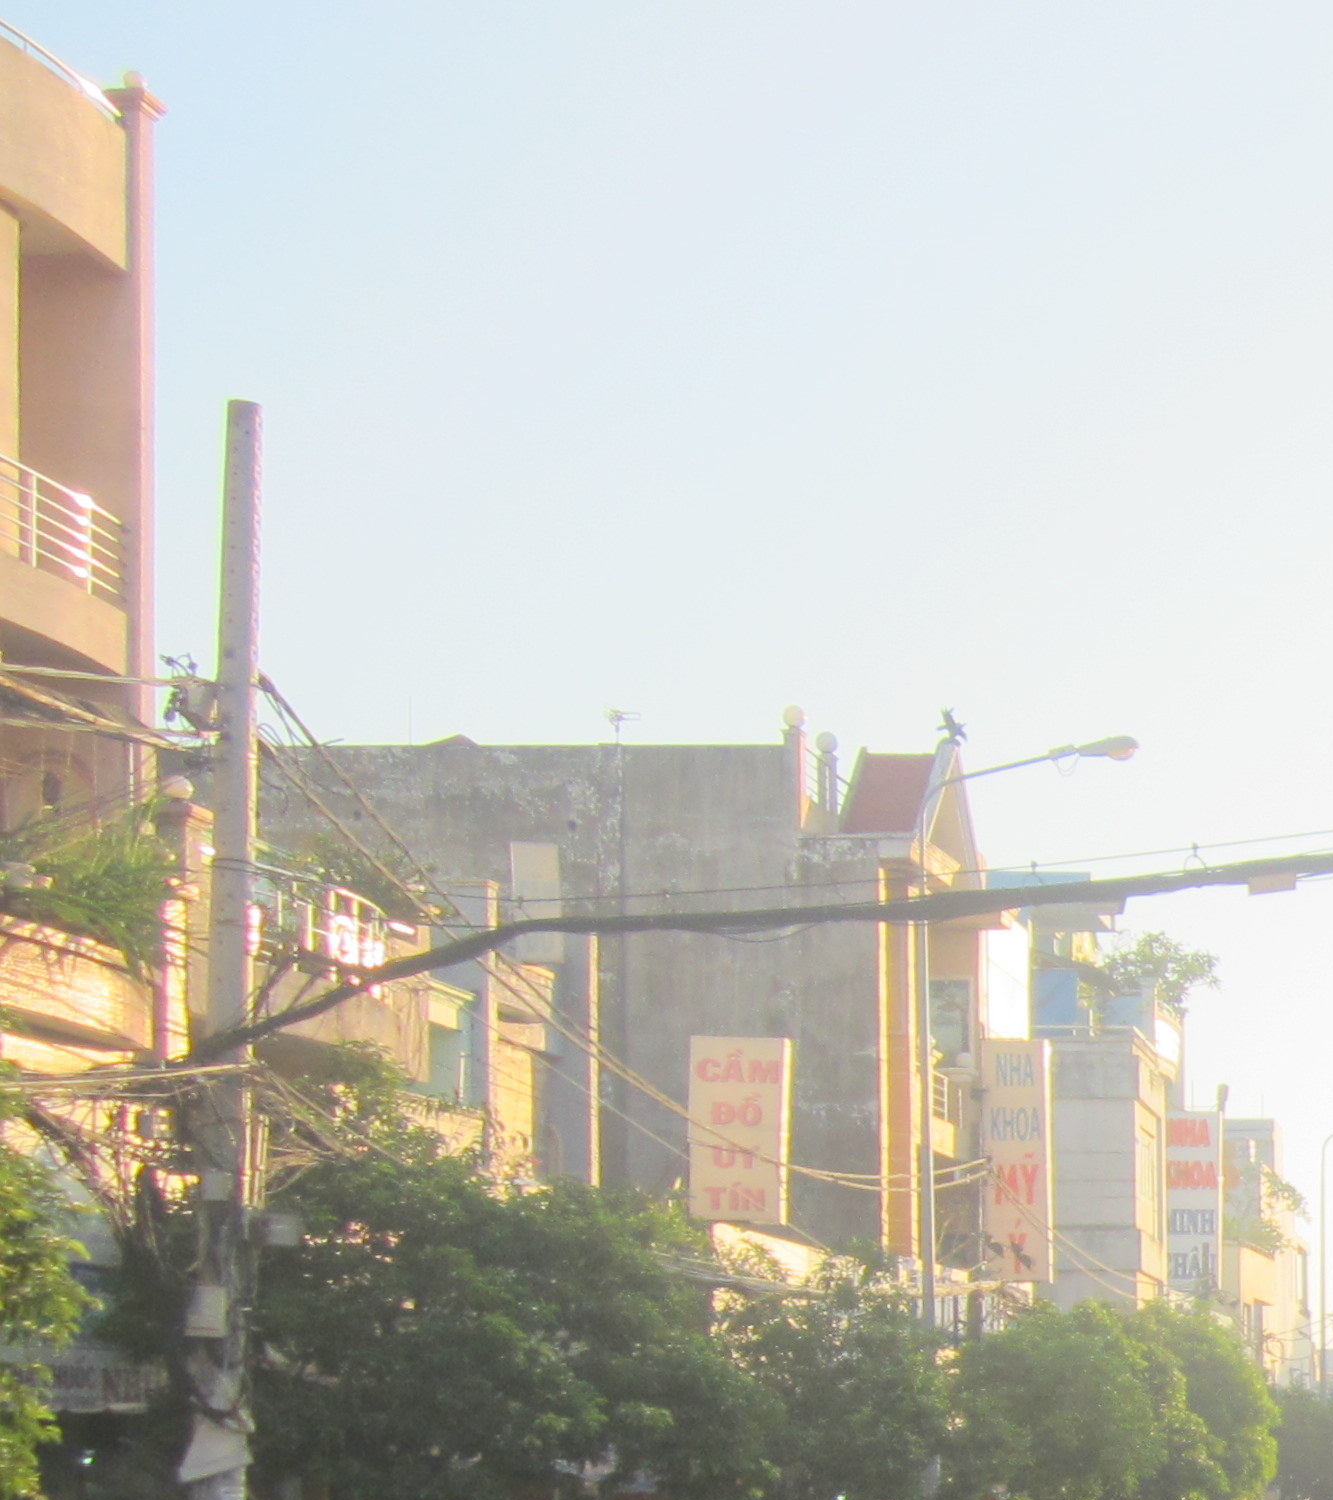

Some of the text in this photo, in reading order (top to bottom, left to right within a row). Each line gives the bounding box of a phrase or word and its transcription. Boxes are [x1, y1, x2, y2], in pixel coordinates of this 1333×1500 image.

[697, 1049, 778, 1083] CẦM
[996, 1053, 1034, 1086] NHA
[711, 1092, 763, 1126] ĐỒ
[991, 1107, 1041, 1141] KHOA
[703, 1181, 766, 1211] TÍN
[995, 1153, 1038, 1205] MỸ
